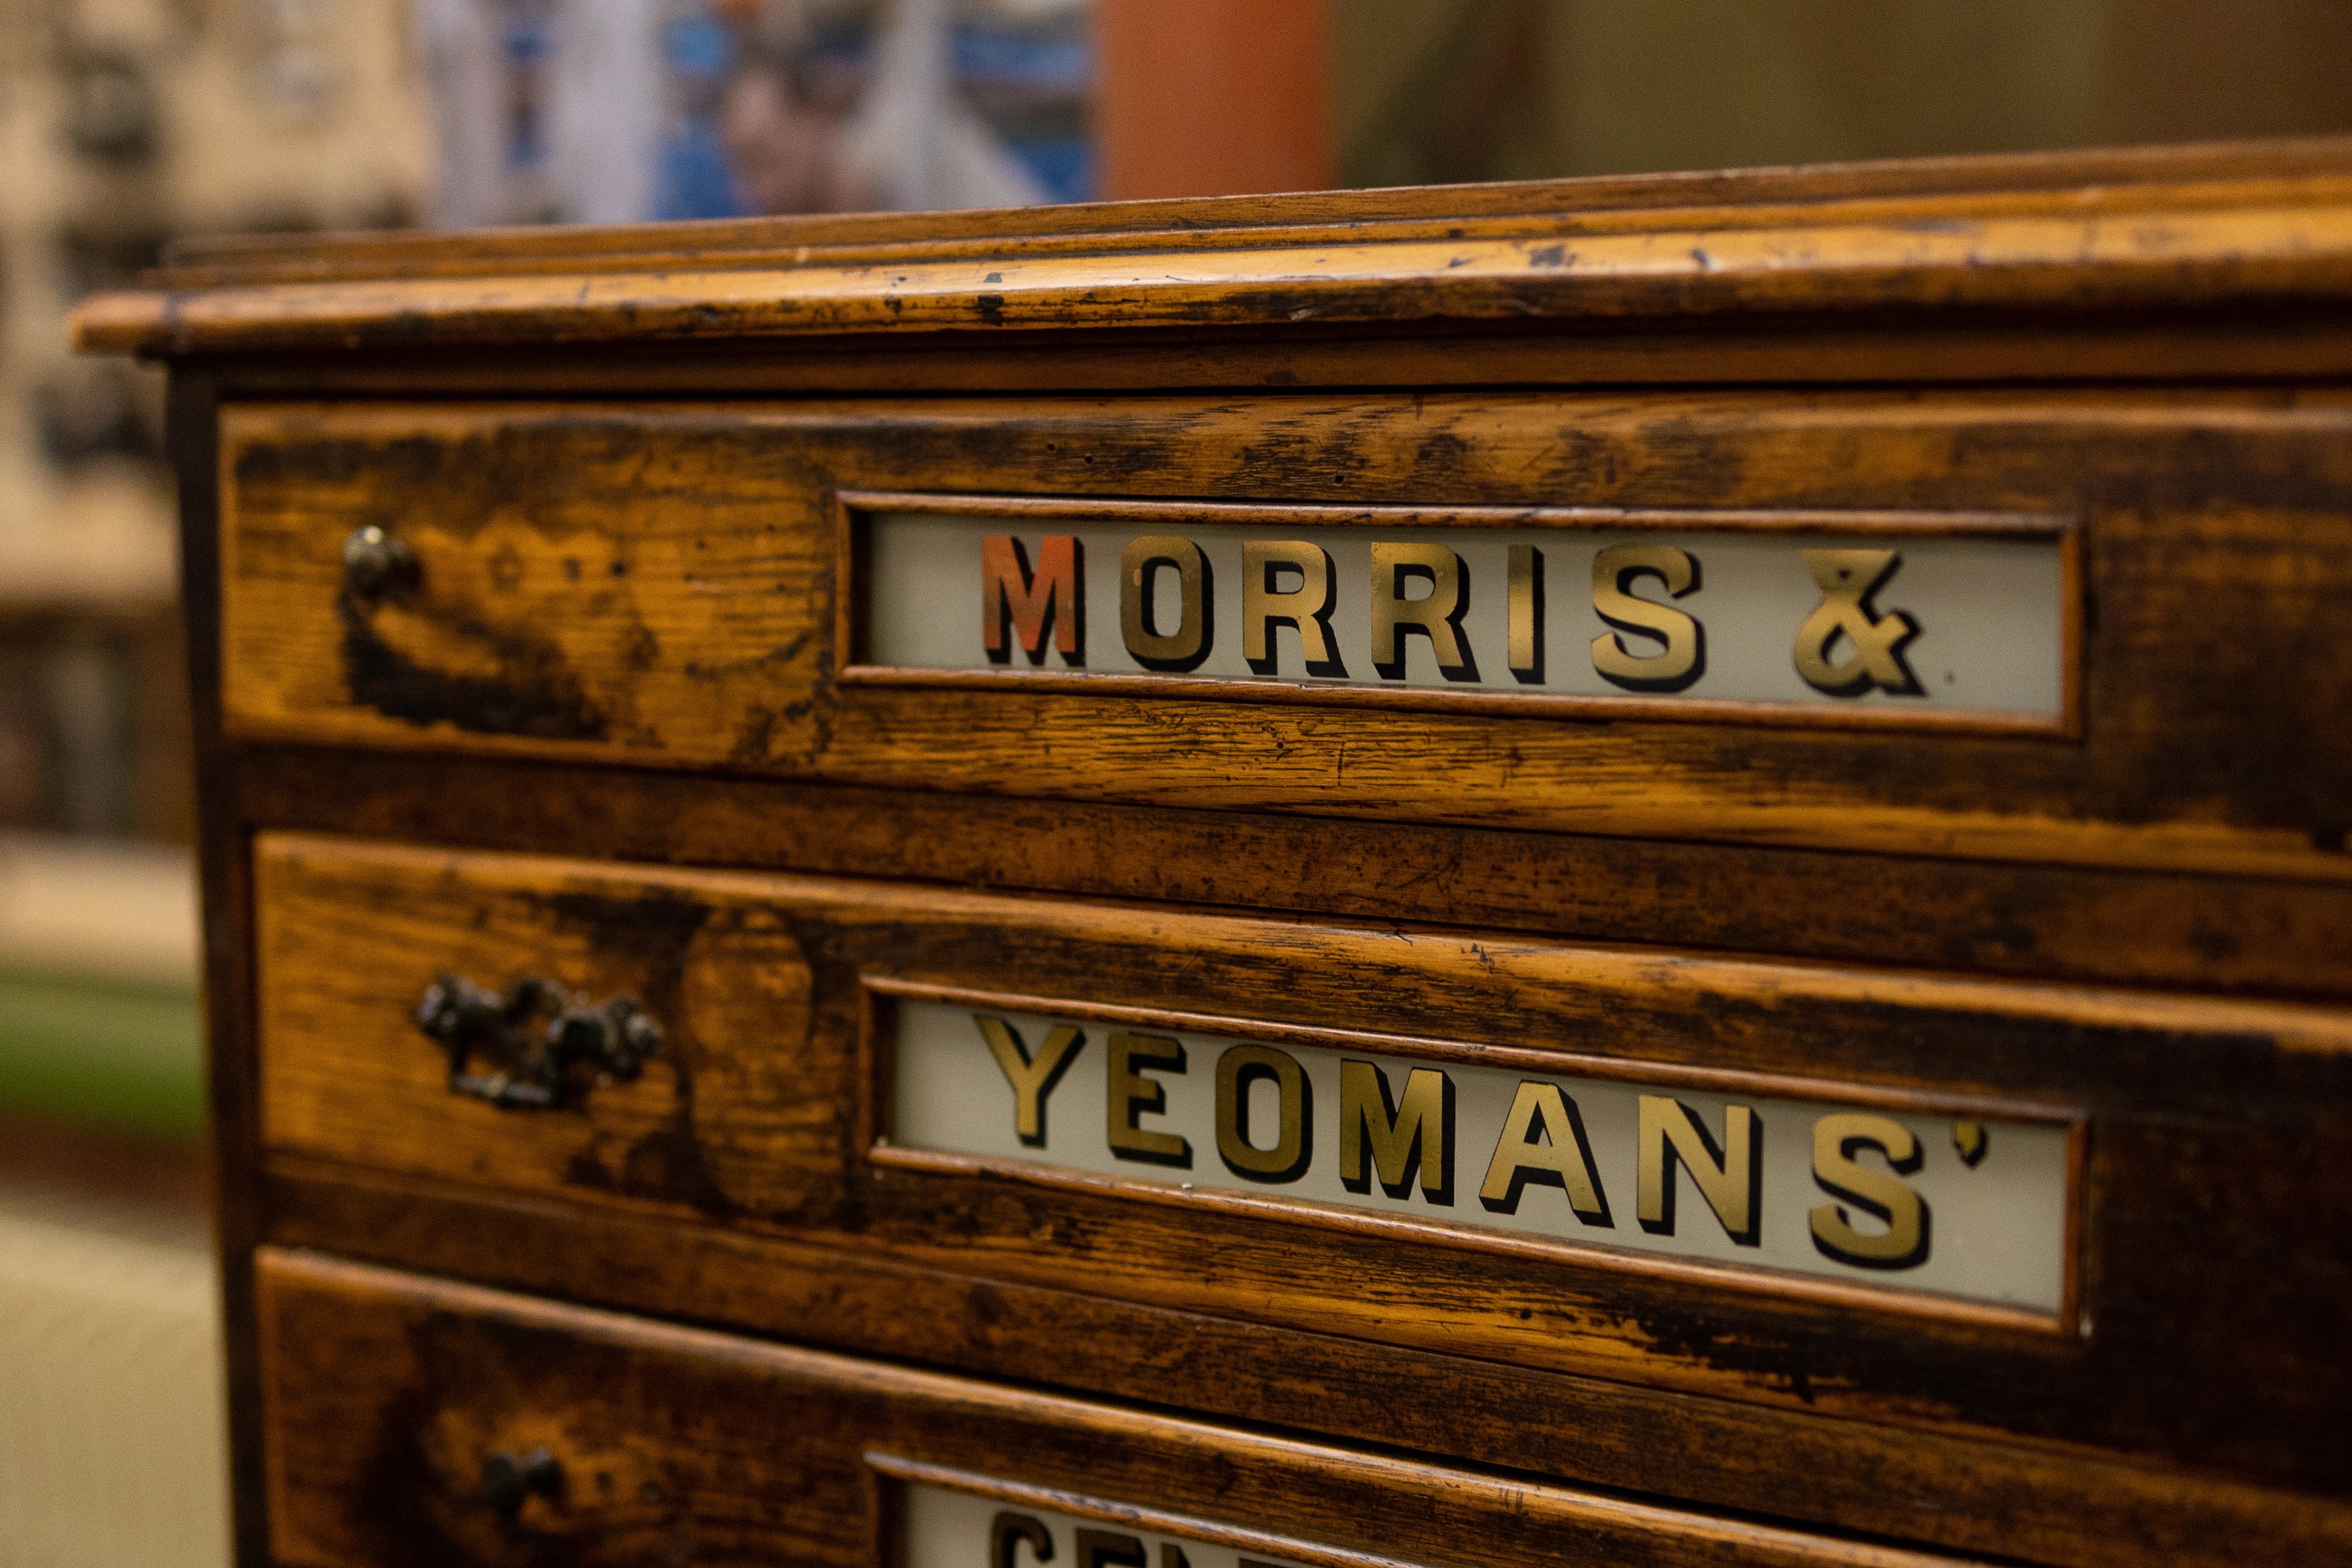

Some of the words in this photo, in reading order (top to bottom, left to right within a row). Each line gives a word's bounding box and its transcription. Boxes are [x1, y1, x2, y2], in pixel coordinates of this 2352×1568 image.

[981, 535, 1707, 693] MORRIS
[1794, 549, 1926, 697] &
[973, 1014, 1989, 1271] YEOMANS'
